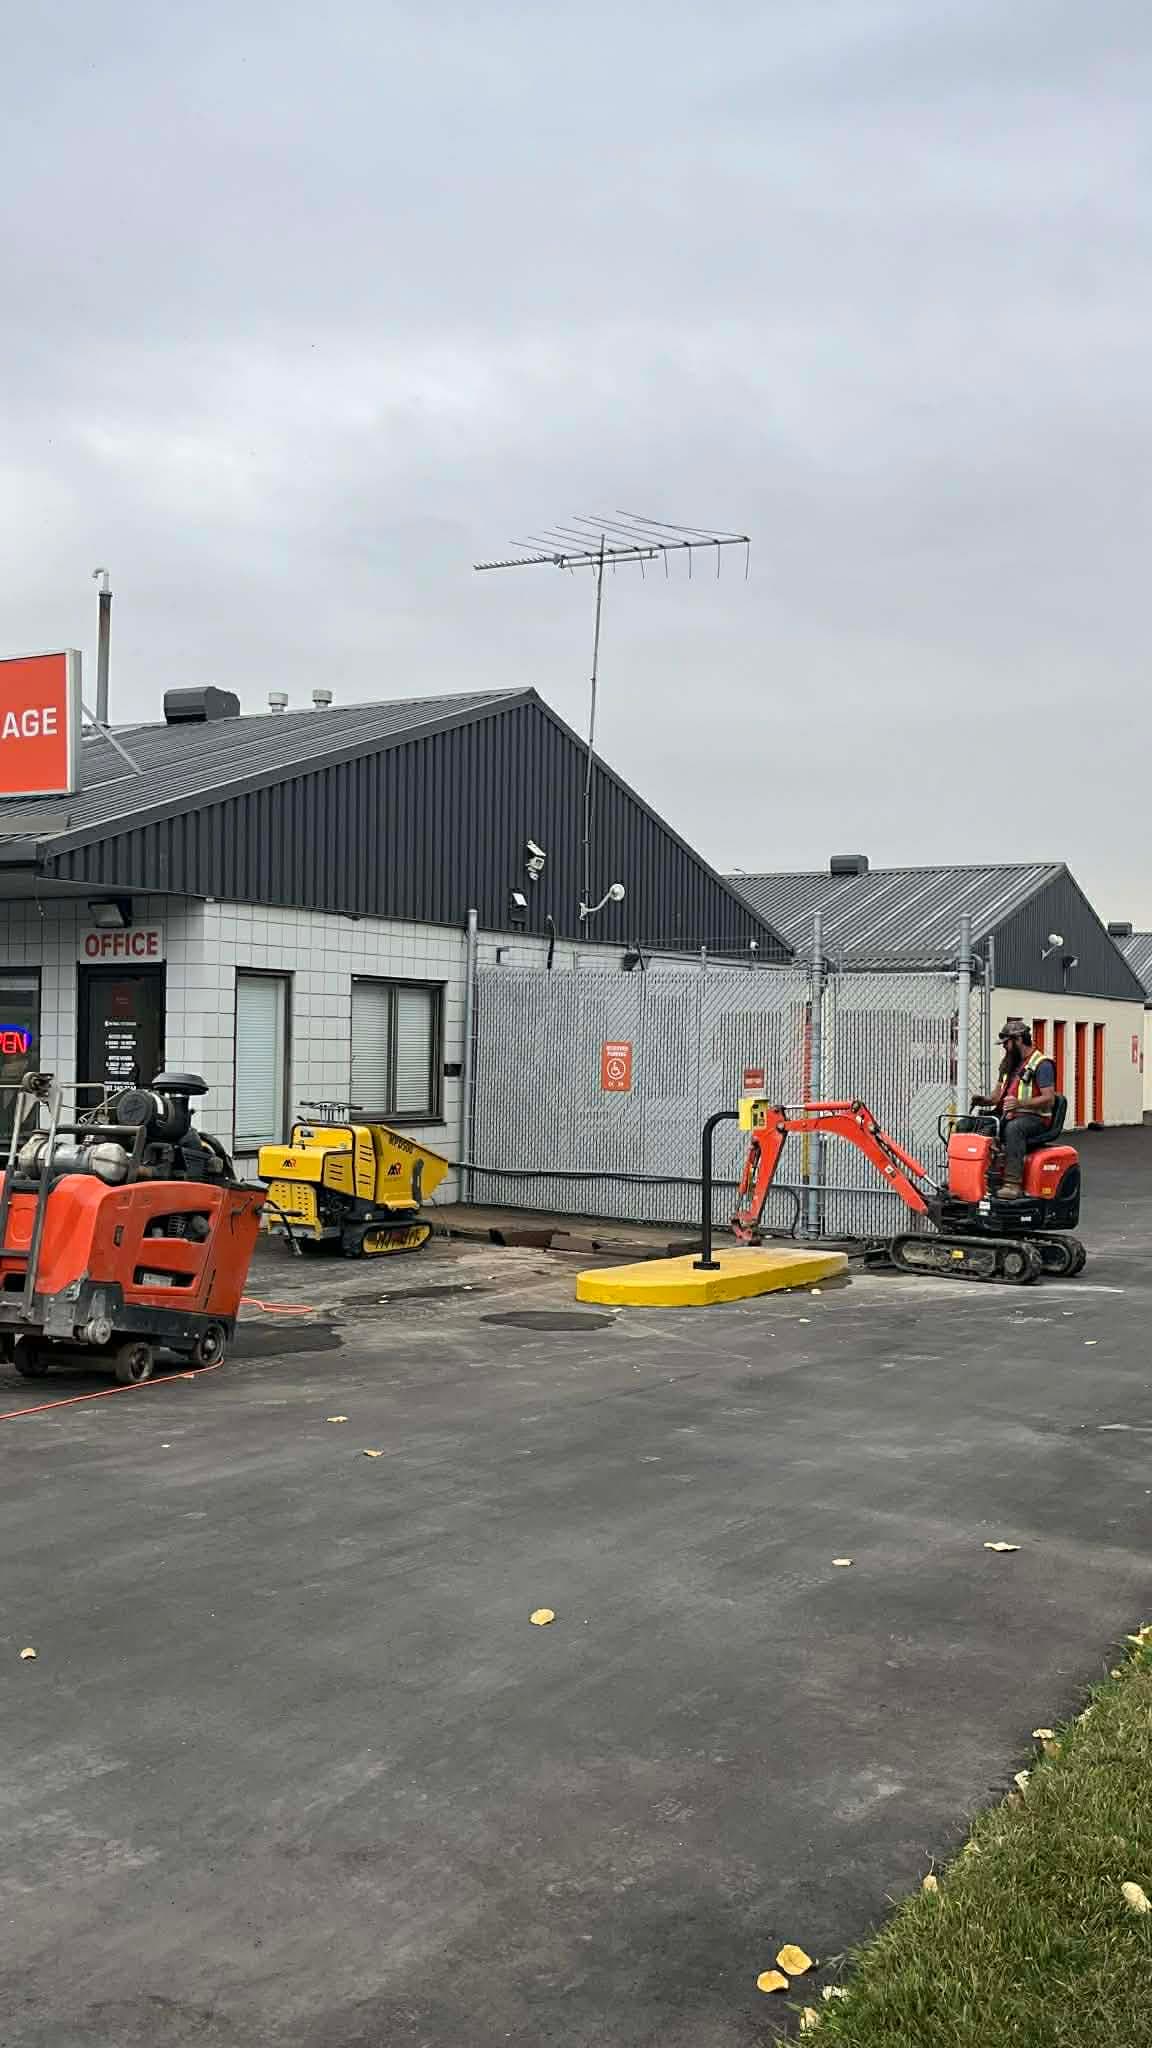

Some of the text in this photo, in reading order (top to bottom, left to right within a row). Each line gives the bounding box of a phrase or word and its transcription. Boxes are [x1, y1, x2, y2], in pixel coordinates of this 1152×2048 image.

[2, 707, 57, 738] AGE
[85, 931, 158, 957] OFFICE
[0, 1032, 27, 1054] EN
